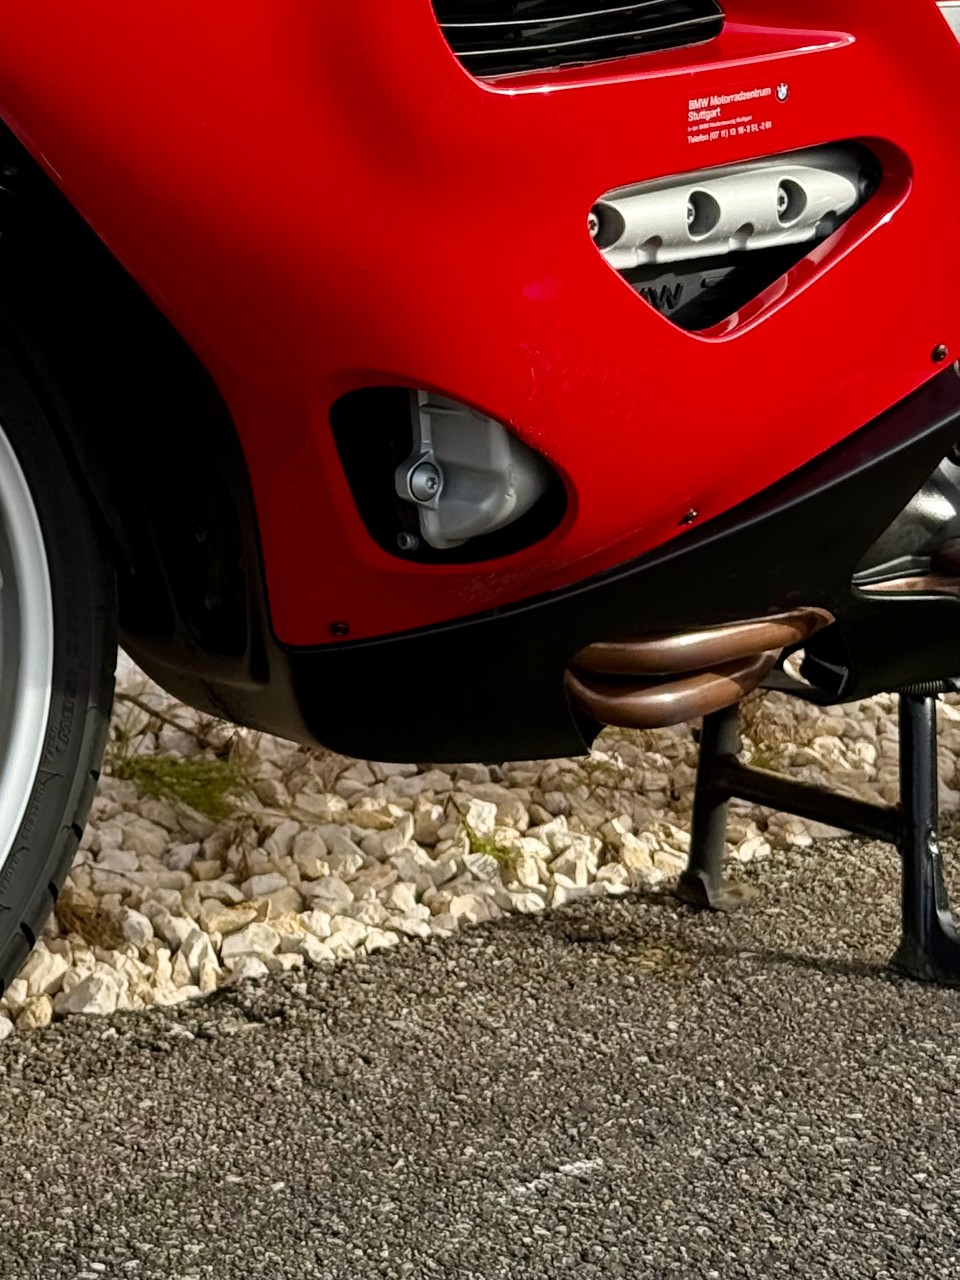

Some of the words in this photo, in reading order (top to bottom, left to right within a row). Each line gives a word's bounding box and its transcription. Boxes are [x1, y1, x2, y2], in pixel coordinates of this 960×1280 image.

[688, 96, 709, 111] BMW
[710, 87, 771, 106] Motorradzentrum
[687, 107, 721, 121] Stuttgart
